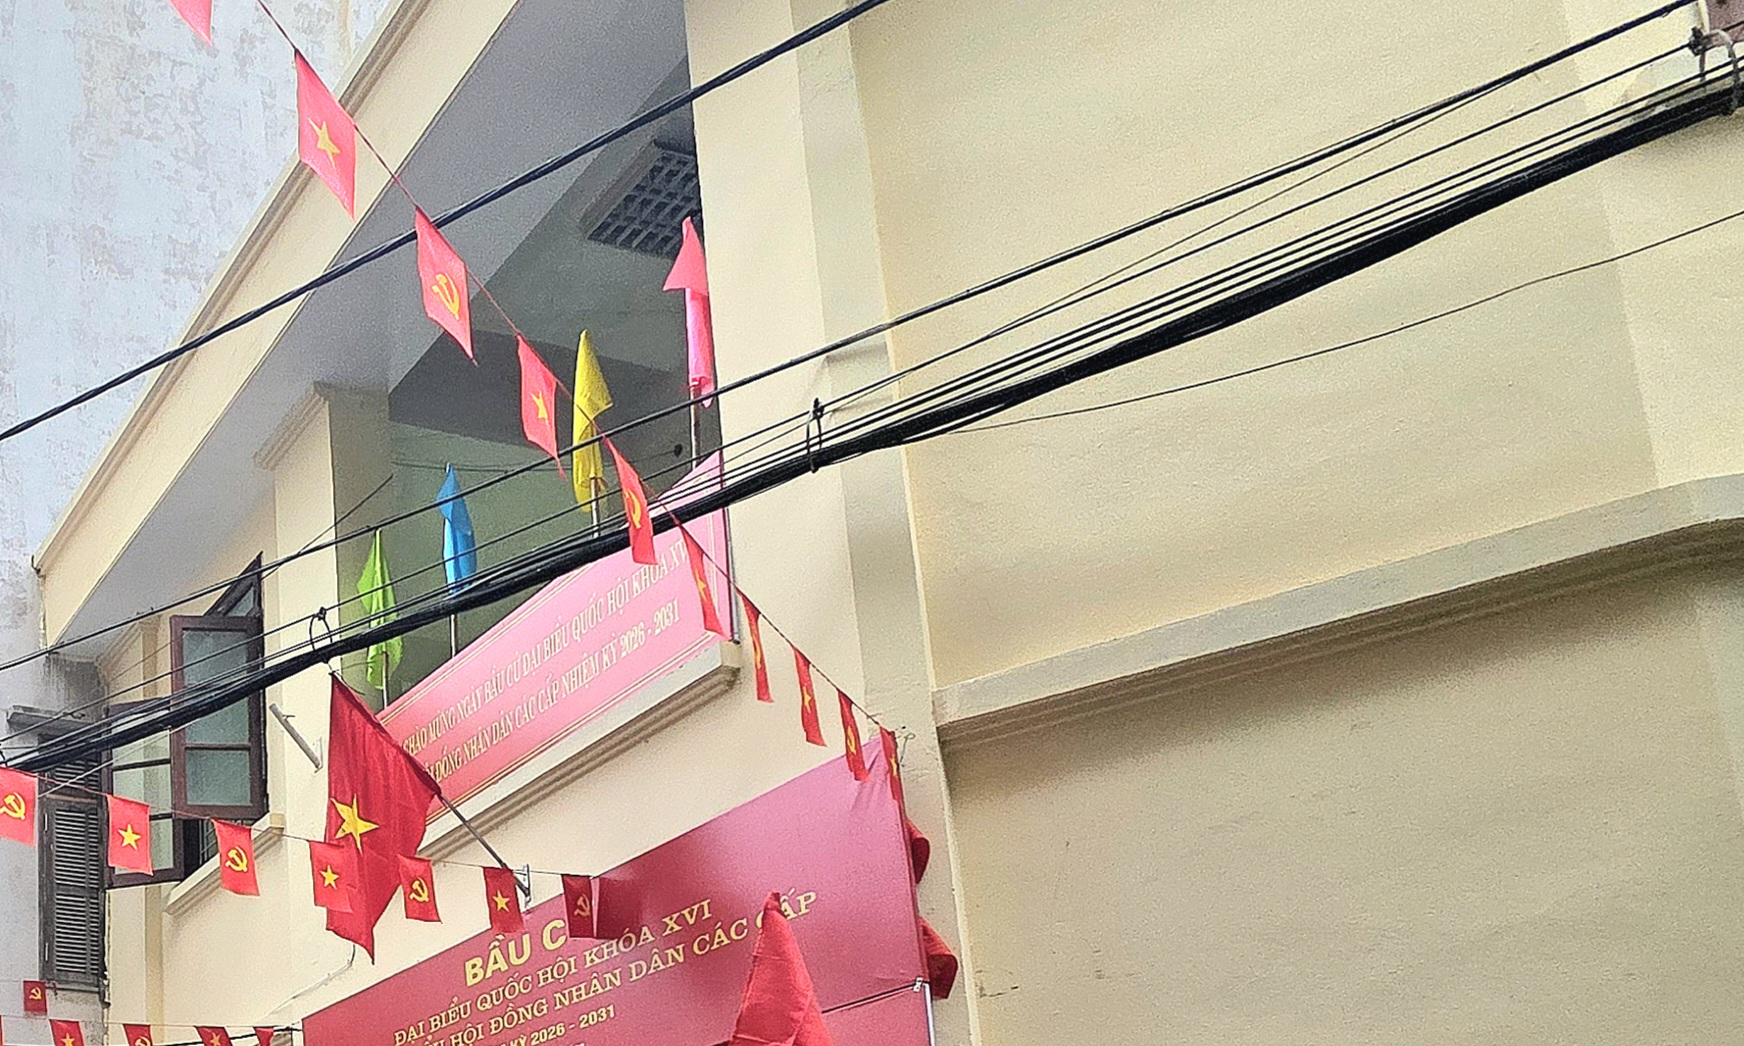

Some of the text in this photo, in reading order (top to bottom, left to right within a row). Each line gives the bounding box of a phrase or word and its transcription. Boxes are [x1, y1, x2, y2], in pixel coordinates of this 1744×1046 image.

[463, 727, 491, 765] NHÂN
[493, 711, 514, 745] DÂN
[515, 695, 535, 728] CÁC
[538, 673, 559, 713] CẤP
[562, 651, 599, 698] NHIỆM
[620, 622, 646, 658] 2026
[654, 600, 680, 635] 2031
[523, 644, 542, 676] ĐẠI
[572, 593, 604, 642] QUỐC
[607, 577, 629, 616] HỘI
[394, 899, 713, 1046] ĐẠI BIỂU QUỐC HỘI KHÓA XVI
[464, 919, 567, 986] BẦU C
[490, 999, 548, 1034] ĐỒNG
[554, 968, 621, 1010] NHÂN
[629, 944, 685, 981] DÂN
[693, 921, 748, 955] CÁC
[757, 888, 817, 928] ẤP
[531, 1023, 565, 1046] 2026
[580, 1005, 615, 1028] 2031
